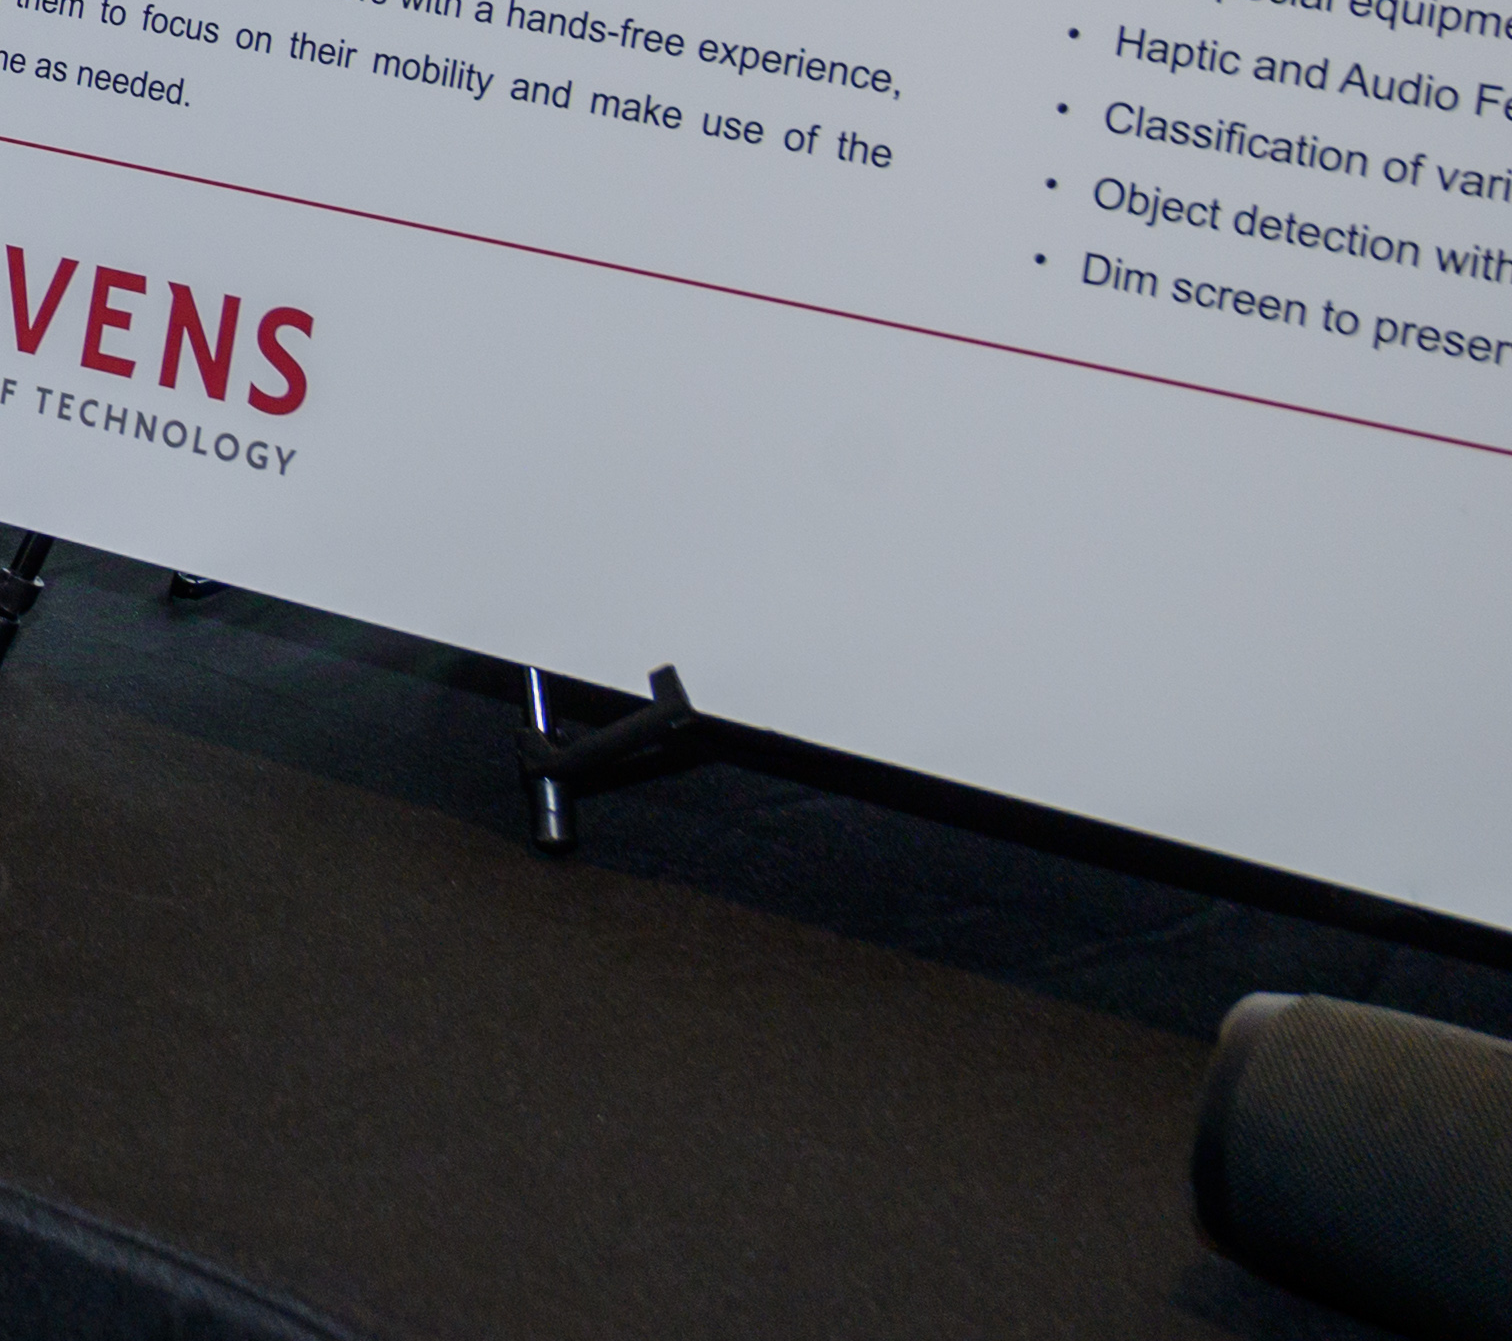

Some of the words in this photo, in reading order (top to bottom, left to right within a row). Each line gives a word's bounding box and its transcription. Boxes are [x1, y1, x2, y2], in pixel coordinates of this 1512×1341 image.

[1115, 25, 1241, 76] Haptic
[1252, 55, 1329, 91] and
[1338, 62, 1460, 112] Audio
[1104, 101, 1368, 177] Classification
[1383, 152, 1427, 186] of
[1437, 165, 1512, 202] vari
[1093, 177, 1221, 231] Object
[1233, 204, 1420, 267] detection
[1082, 251, 1158, 297] Dim
[1171, 277, 1307, 326] screen
[1323, 300, 1360, 336] to
[35, 385, 297, 476] TECHNOLOGY
